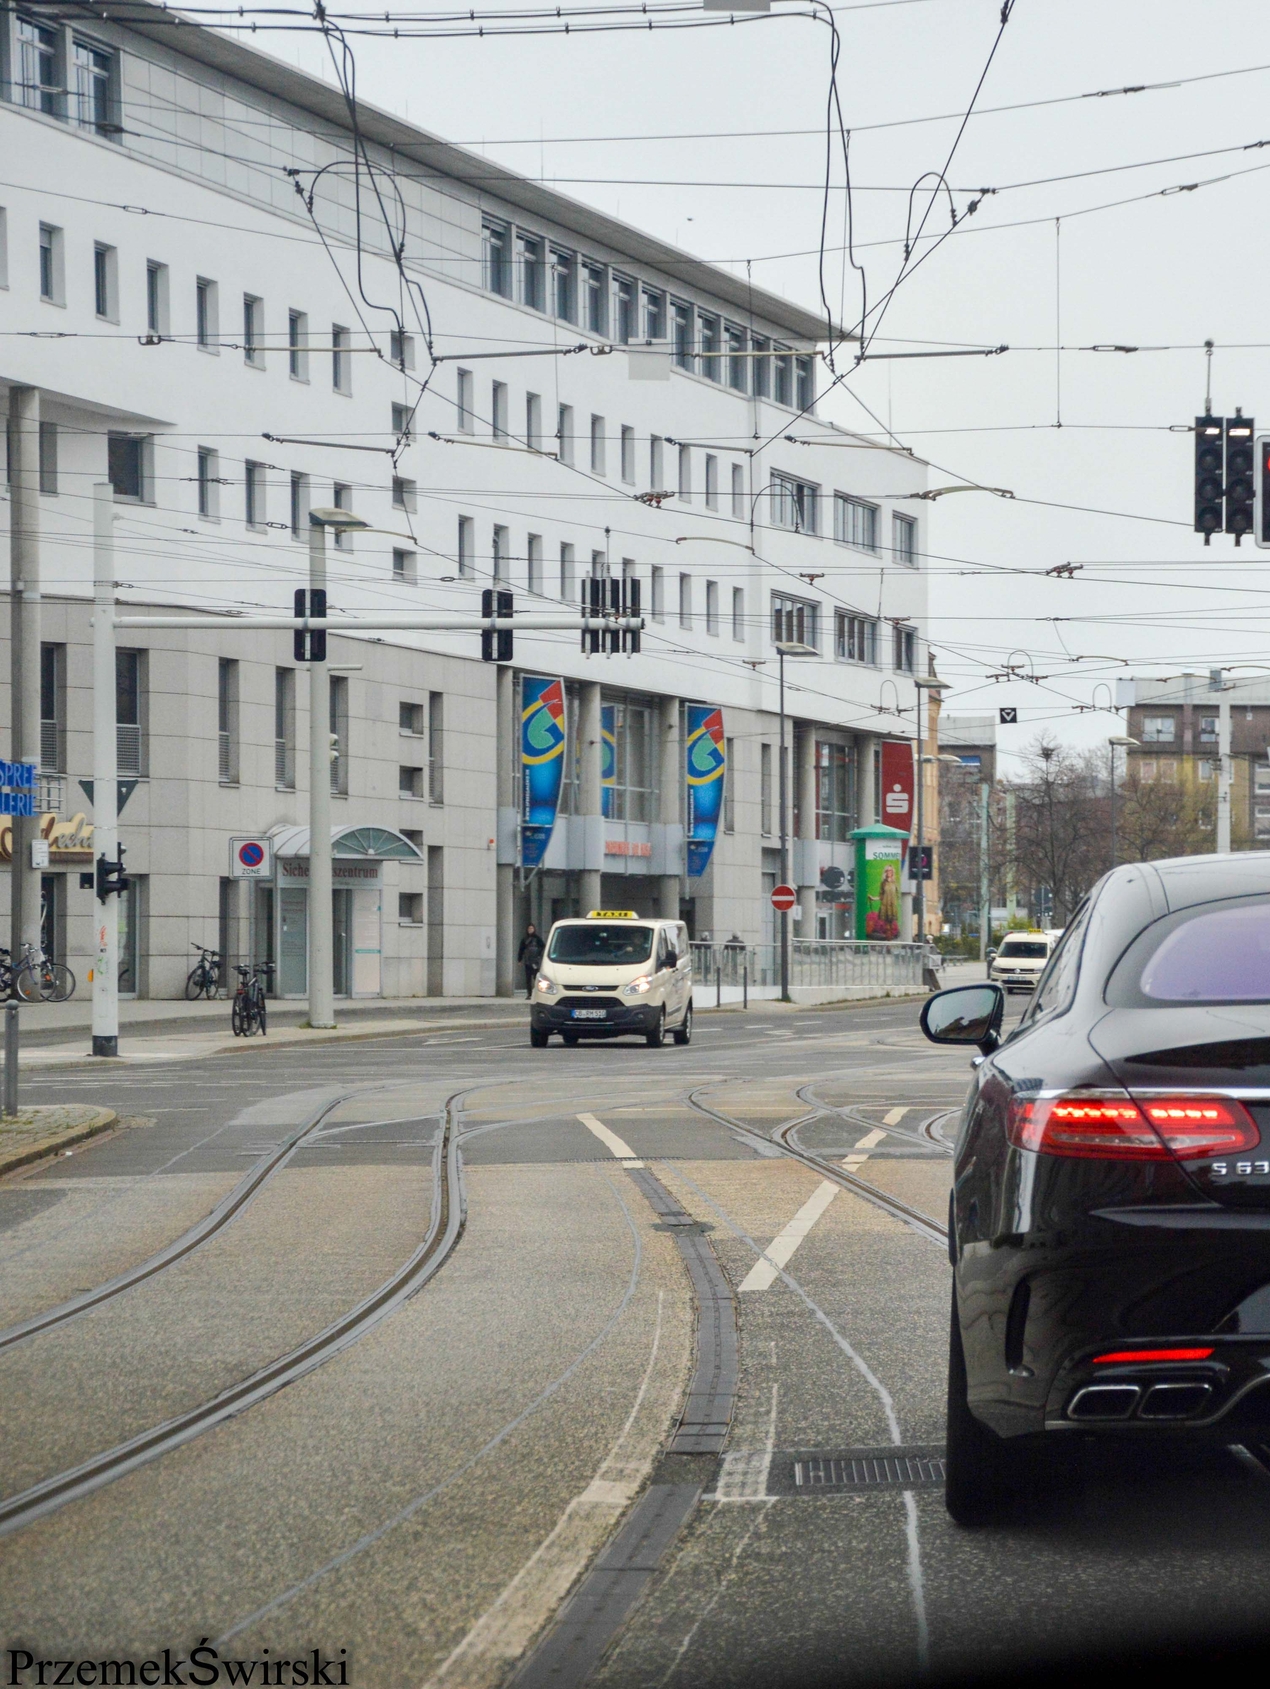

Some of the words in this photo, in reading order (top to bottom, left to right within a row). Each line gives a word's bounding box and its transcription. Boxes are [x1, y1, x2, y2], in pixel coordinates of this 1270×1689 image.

[0, 793, 38, 816] LERIE
[282, 862, 378, 878] Sicheszentrum
[1211, 1163, 1227, 1176] S
[1236, 1162, 1270, 1175] 63
